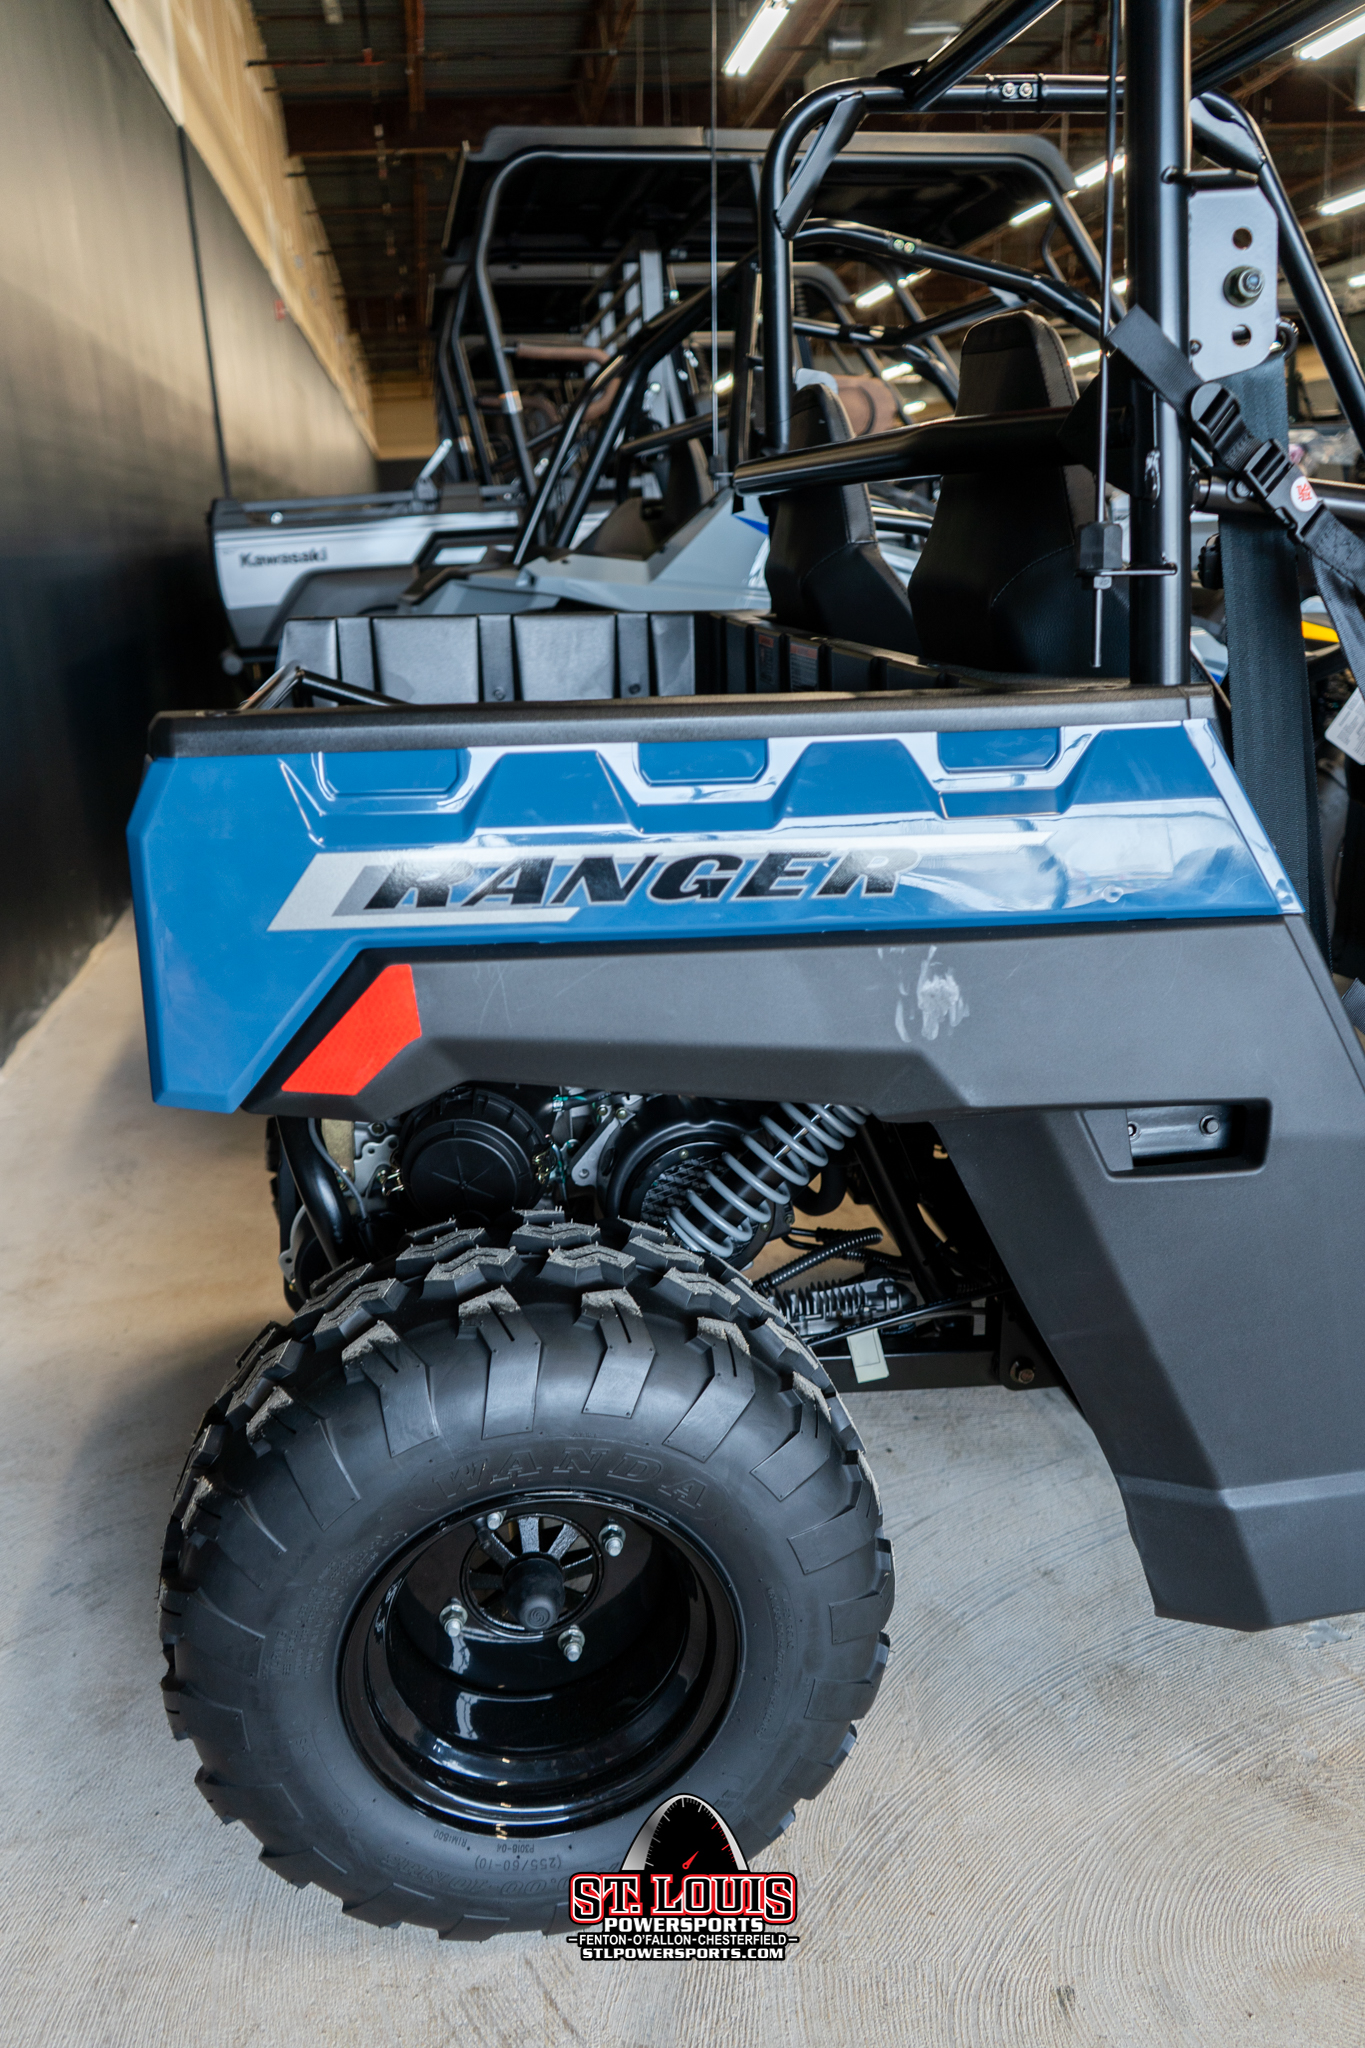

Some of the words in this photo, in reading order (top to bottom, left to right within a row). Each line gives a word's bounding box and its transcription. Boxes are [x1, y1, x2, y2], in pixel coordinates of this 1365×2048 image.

[239, 546, 328, 568] Kawasaki
[363, 849, 921, 910] RANGER
[432, 1447, 708, 1509] WANDA
[475, 1854, 562, 1871] (255/60-10)
